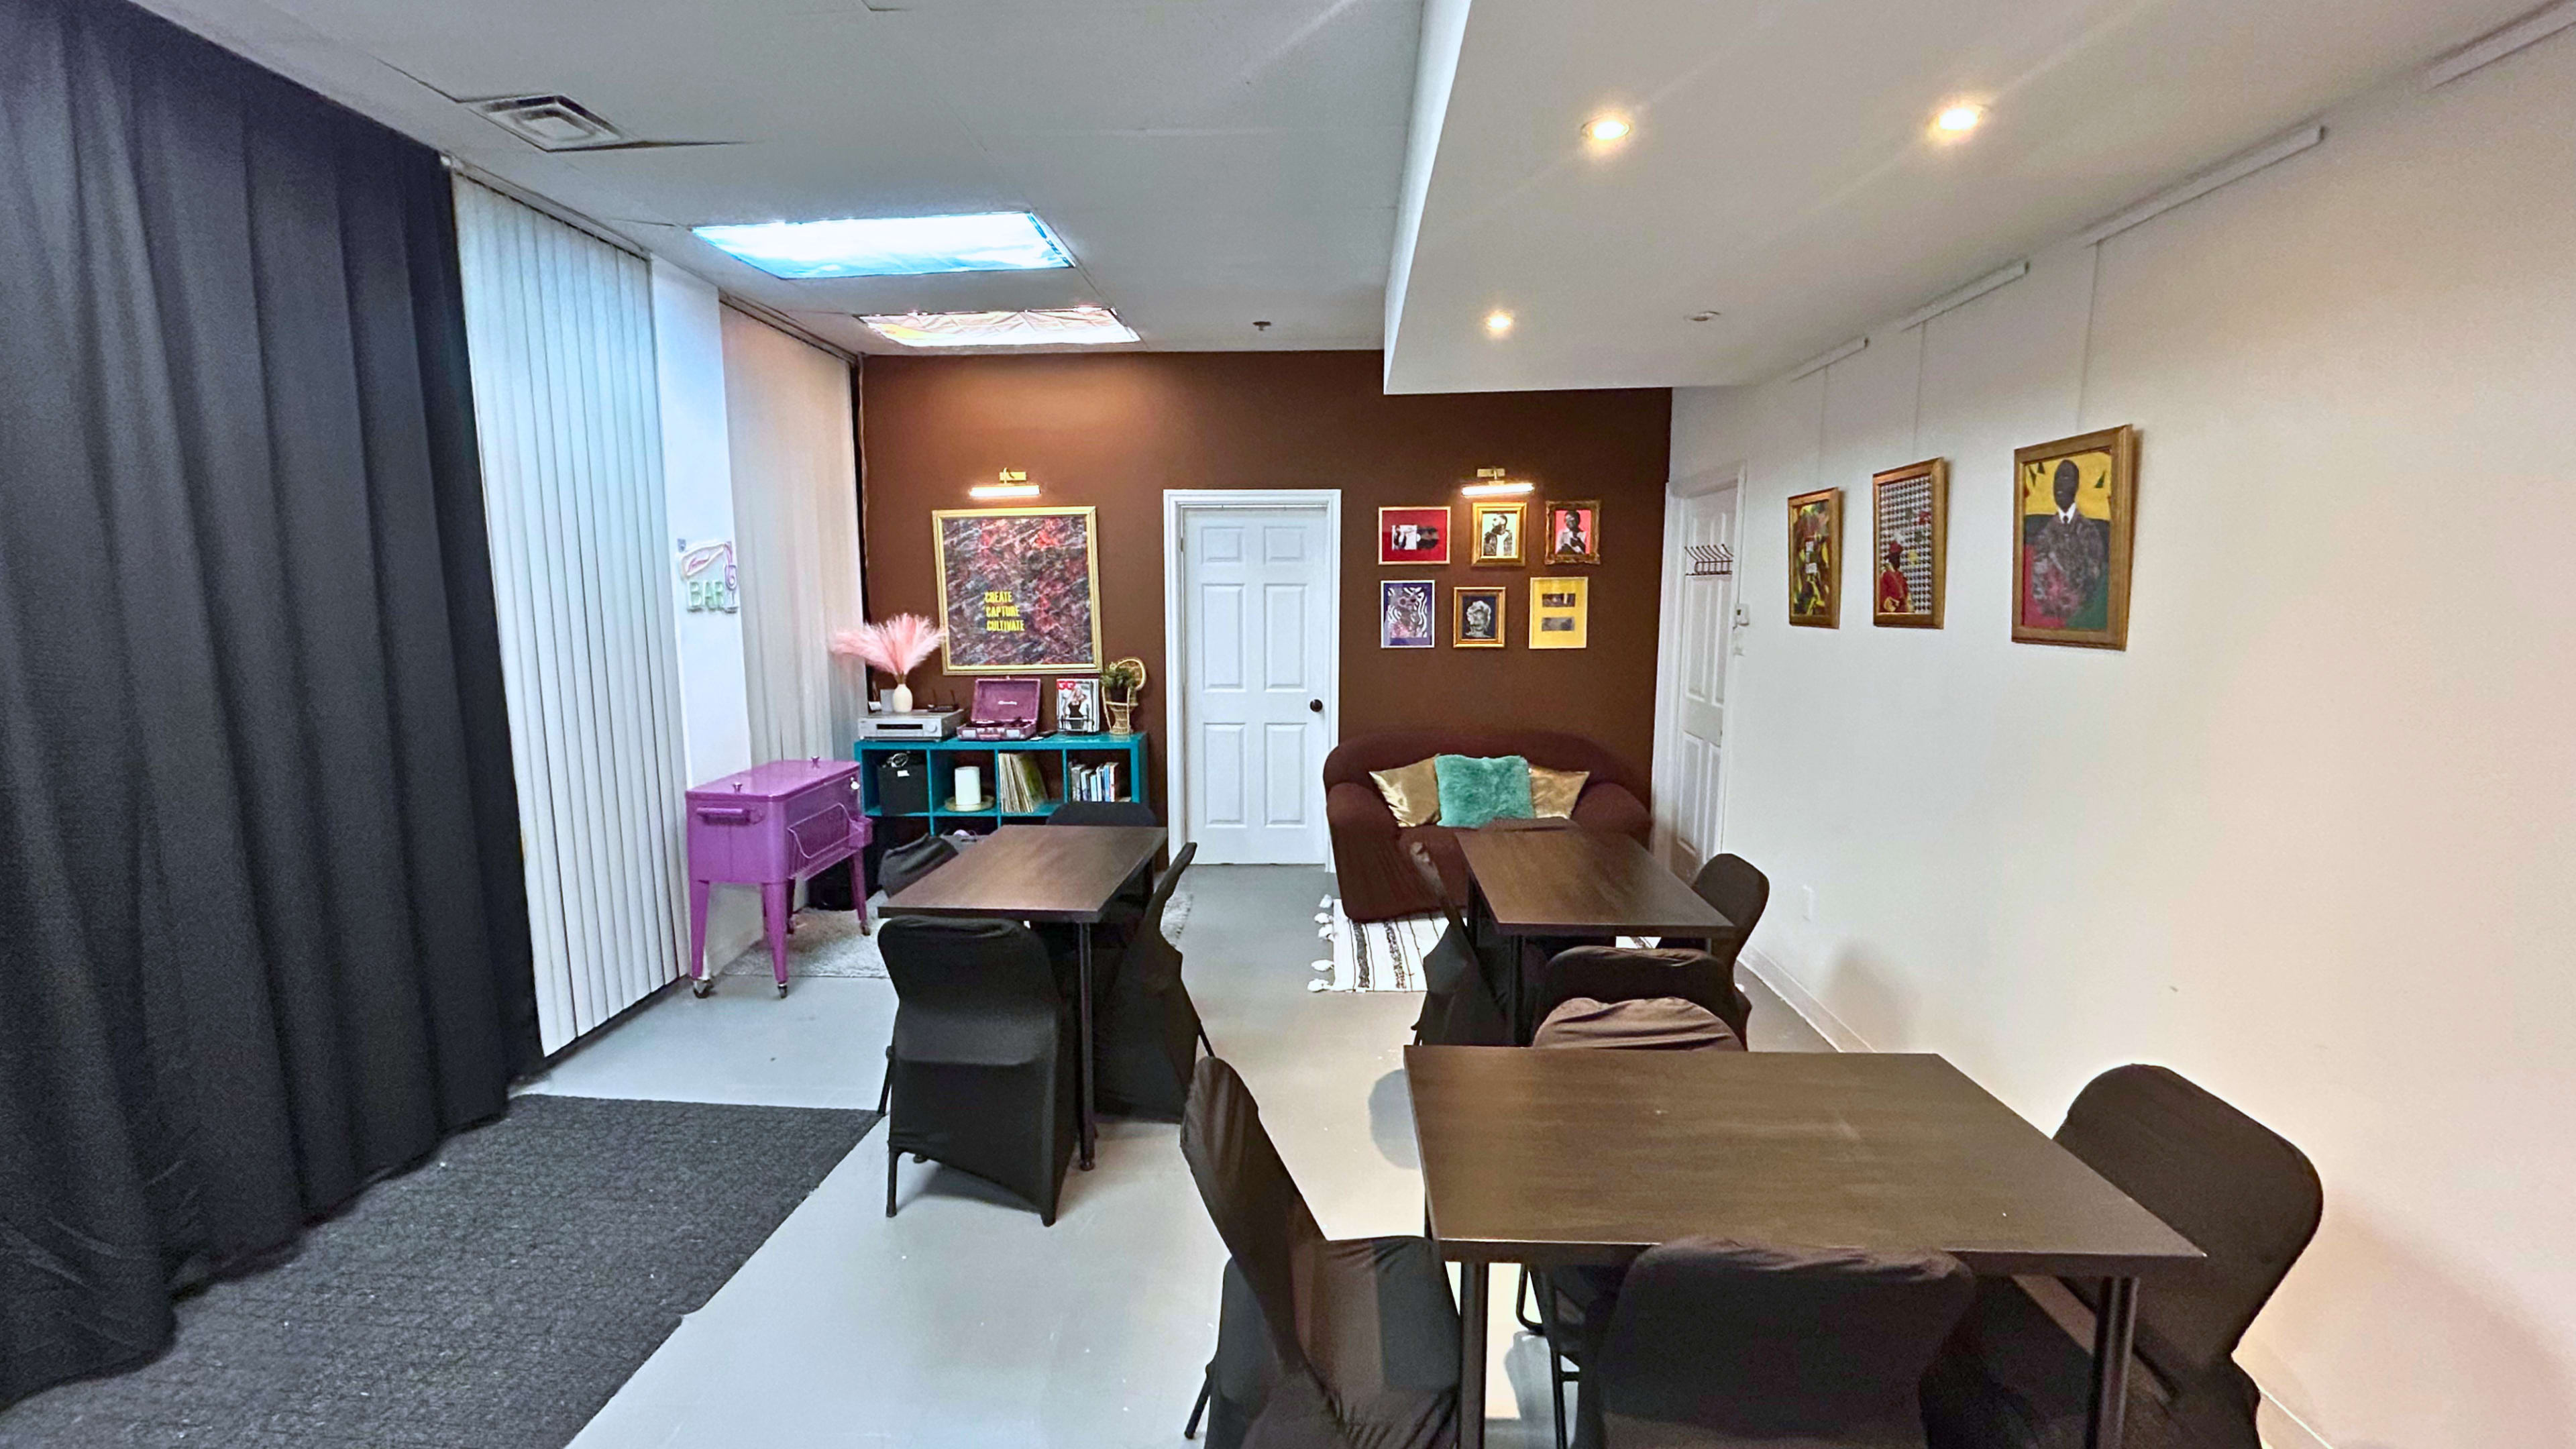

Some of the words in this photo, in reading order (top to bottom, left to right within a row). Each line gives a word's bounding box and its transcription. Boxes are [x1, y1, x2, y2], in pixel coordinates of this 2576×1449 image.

[688, 580, 724, 610] BAR
[985, 591, 1012, 602] CREATE
[986, 605, 1020, 617] CAPTURE
[986, 620, 1025, 631] CULTIVATE
